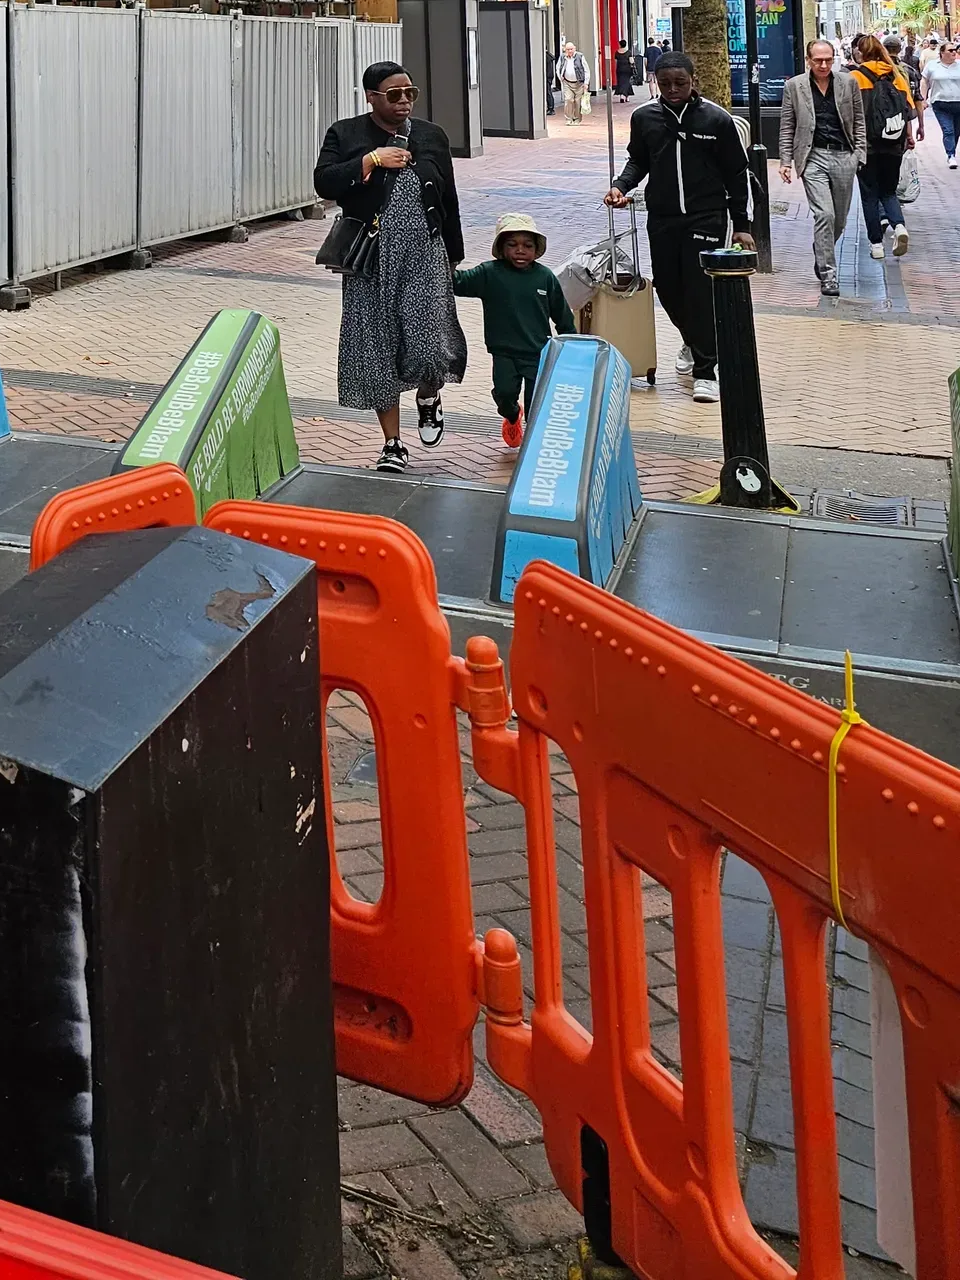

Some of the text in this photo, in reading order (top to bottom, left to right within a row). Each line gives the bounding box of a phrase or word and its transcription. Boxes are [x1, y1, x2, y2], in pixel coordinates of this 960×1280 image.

[139, 351, 224, 460] #BeBoldBeBham
[192, 453, 206, 491] BE
[202, 418, 224, 470] BOLD
[221, 398, 236, 433] BE
[231, 323, 276, 414] BIRMINGHAM
[528, 383, 585, 508] #BeBoldBeBham
